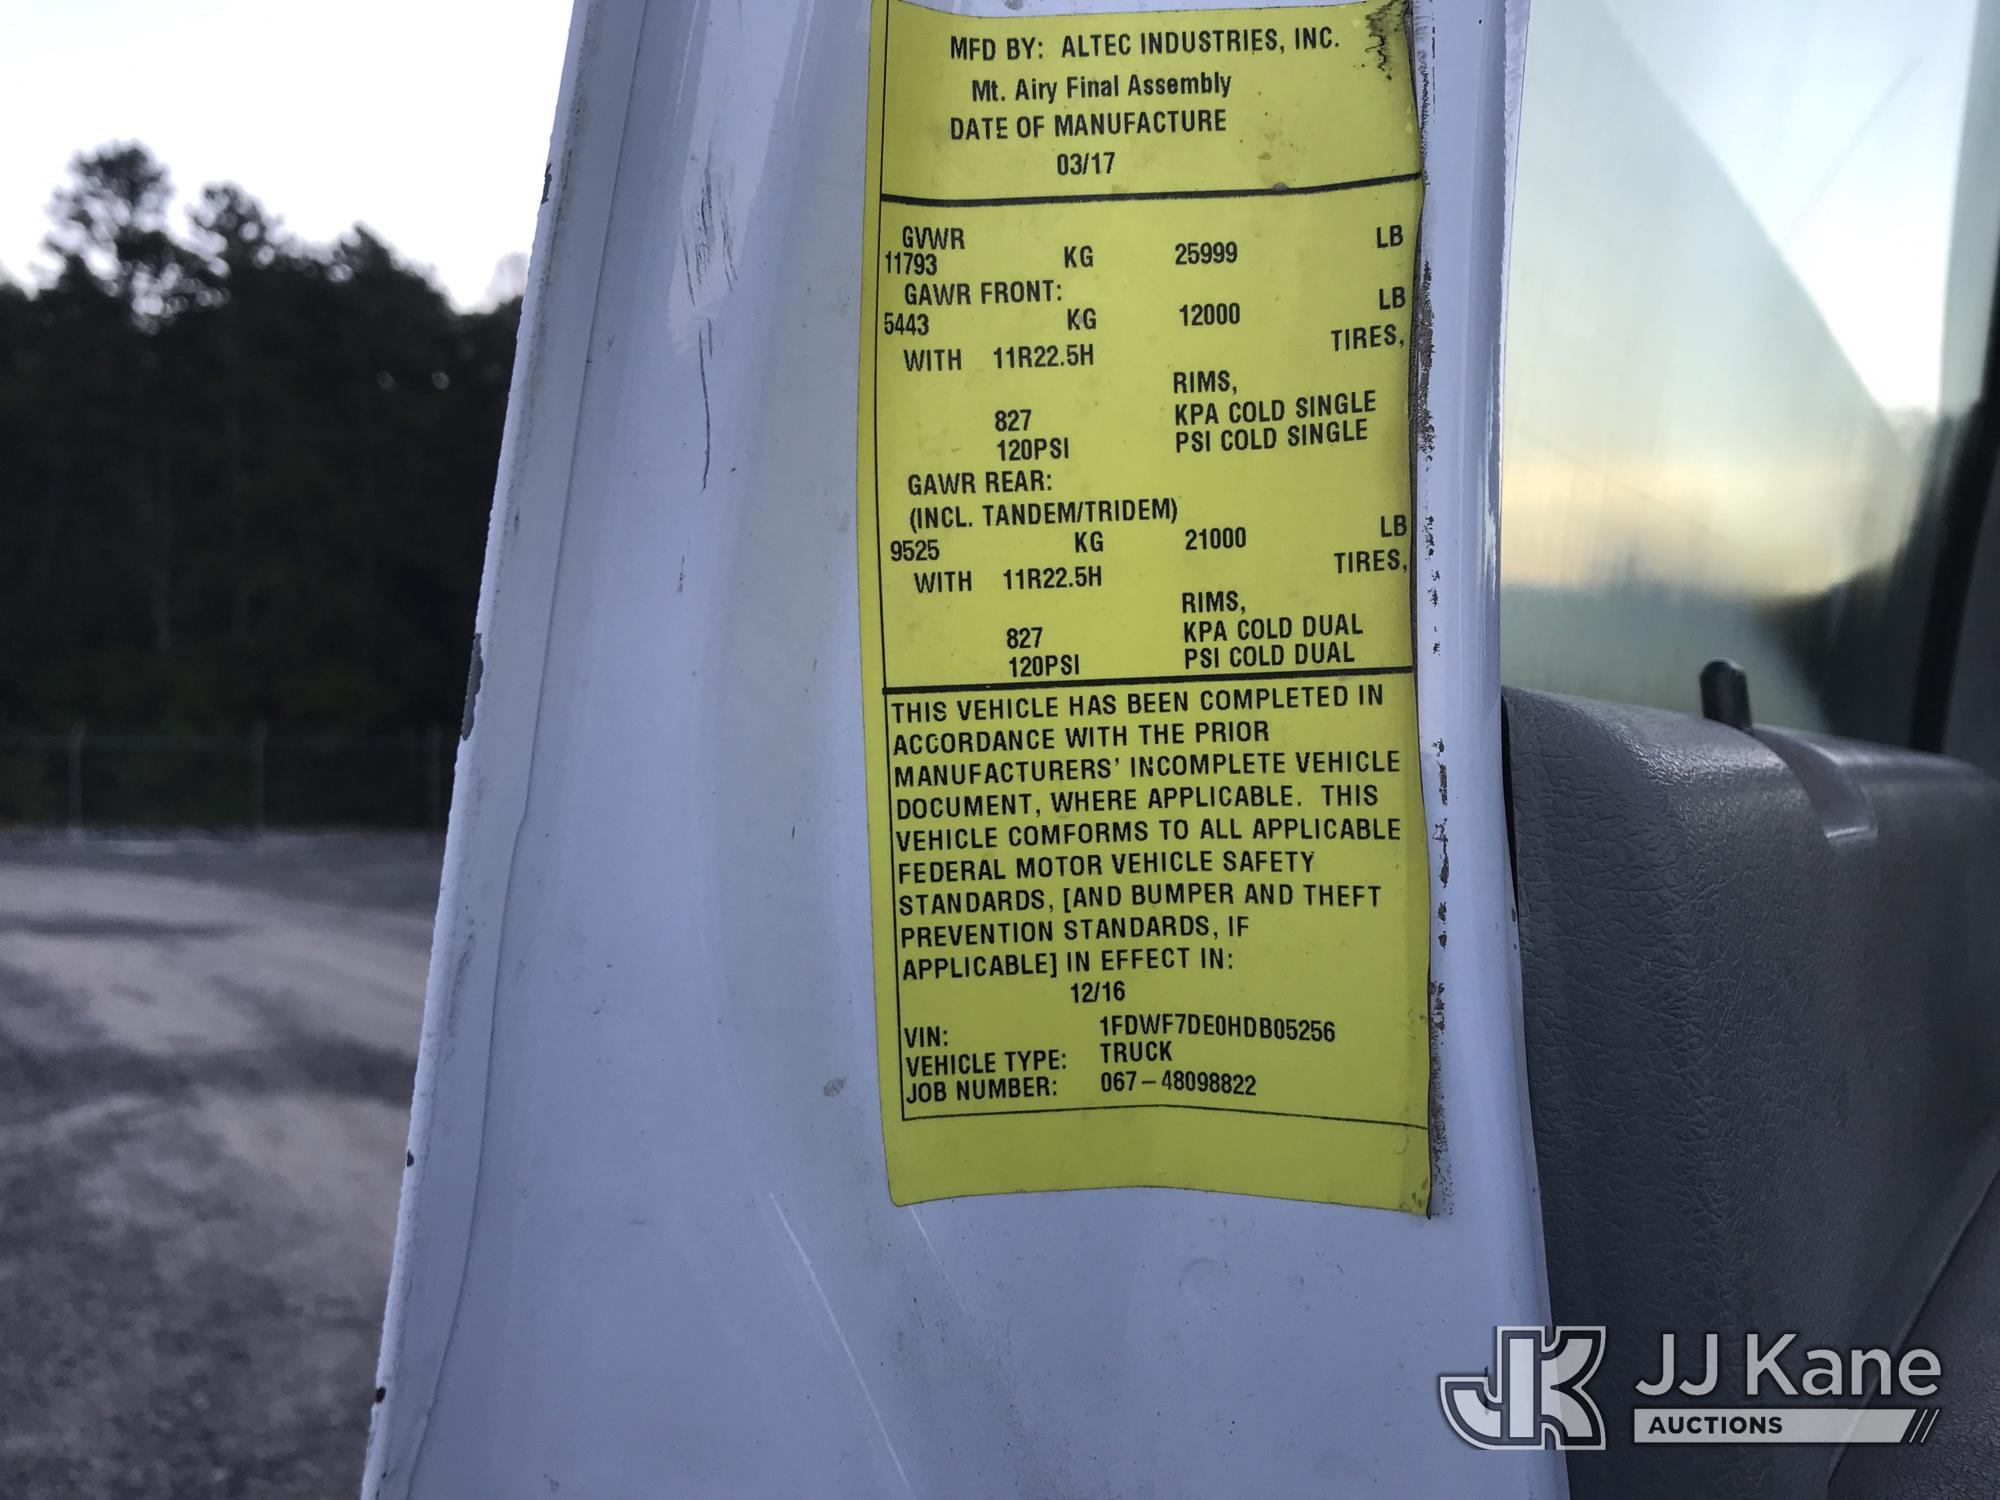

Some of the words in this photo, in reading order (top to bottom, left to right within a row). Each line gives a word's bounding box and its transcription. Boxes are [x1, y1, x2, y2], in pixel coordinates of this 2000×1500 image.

[950, 35, 996, 61] MFD
[1006, 36, 1043, 61] BY:
[1061, 33, 1131, 58] ALTEC
[1140, 28, 1285, 55] INDUSTRIES,
[1294, 26, 1339, 50] INC.
[971, 79, 1006, 102] Mt.
[1015, 77, 1058, 105] Airy
[1066, 74, 1119, 99] Final
[1127, 71, 1232, 98] Assembly
[950, 116, 1008, 141] DATE
[1016, 115, 1045, 139] OF
[1054, 108, 1227, 137] MANUFACTURE
[1056, 151, 1116, 176] 03/17
[885, 250, 938, 276] 11793
[1063, 244, 1094, 269] KG
[1174, 241, 1238, 266] 25999
[1376, 224, 1404, 249] LB
[902, 225, 966, 250] GVWR
[904, 282, 972, 306] GAWR
[980, 279, 1062, 305] FRONT:
[884, 311, 930, 336] 5443
[1067, 307, 1097, 331] KG
[1179, 302, 1241, 327] 12000
[1378, 286, 1407, 311] LB
[903, 348, 962, 372] WITH
[993, 343, 1094, 369] 11R22.5H
[1330, 323, 1405, 352] TIRES,
[1173, 369, 1237, 395] RIMS,
[994, 408, 1032, 432] 827
[1175, 402, 1219, 426] KPA
[1228, 399, 1285, 424] COLD
[1295, 389, 1376, 419] SINGLE
[996, 437, 1069, 462] 120PSI
[1175, 430, 1211, 454] PSI
[1220, 427, 1277, 452] COLD
[1287, 418, 1368, 447] SINGLE
[907, 472, 977, 496] GAWR
[985, 469, 1052, 493] REAR:
[909, 505, 973, 534] (INCL.
[982, 497, 1178, 527] TANDEM/TRIDEM)
[890, 538, 940, 562] 9525
[1074, 530, 1104, 554] KG
[1185, 526, 1247, 551] 21000
[1380, 513, 1408, 538] LB
[913, 570, 972, 594] WITH
[1002, 565, 1102, 591] 11R22.5H
[1333, 548, 1408, 574] TIRES,
[1181, 590, 1246, 615] RIMS,
[1006, 626, 1043, 650] 827
[1183, 620, 1228, 643] KPA
[1237, 616, 1293, 641] COLD
[1302, 612, 1364, 638] DUAL
[1008, 653, 1080, 678] 120PSI
[1184, 647, 1219, 670] PSI
[1229, 644, 1285, 668] COLD
[1294, 641, 1355, 665] DUAL
[890, 701, 947, 724] THIS
[956, 696, 1058, 721] VEHICLE
[1069, 694, 1117, 716] HAS
[1127, 691, 1188, 714] BEEN
[1200, 685, 1348, 711] COMPLETED
[1358, 683, 1383, 706] IN
[893, 728, 1055, 756] ACCORDANCE
[1064, 725, 1127, 749] WITH
[1138, 723, 1185, 745] THE
[1195, 720, 1270, 743] PRIOR
[1130, 752, 1286, 778] INCOMPLETE
[1295, 750, 1400, 774] VEHICLE
[896, 793, 1041, 820] DOCUMENT,
[1050, 788, 1137, 813] WHERE
[1147, 784, 1302, 809] APPLICABLE.
[1320, 784, 1378, 807] THIS
[895, 827, 998, 853] VEHICLE
[1008, 820, 1149, 847] COMFORMS
[1158, 818, 1189, 841] TO
[1199, 818, 1243, 840] ALL
[1252, 818, 1401, 841] APPLICABLE
[898, 858, 1006, 885] FEDERAL
[1016, 854, 1103, 879] MOTOR
[1110, 850, 1213, 875] VEHICLE
[1223, 850, 1314, 873] SAFETY
[899, 888, 1054, 917] STANDARDS,
[1063, 885, 1122, 914] [AND
[1131, 882, 1234, 906] BUMPER
[1244, 883, 1294, 906] AND
[1302, 884, 1382, 908] THEFT
[901, 920, 1053, 949] PREVENTION
[1063, 915, 1218, 941] STANDARDS,
[1228, 915, 1249, 937] IF
[902, 952, 1058, 981] APPLICABLE]
[1066, 950, 1090, 973] IN
[1101, 947, 1190, 971] EFFECT
[1200, 947, 1233, 970] IN:
[1070, 980, 1126, 1004] 12/16
[903, 1025, 948, 1049] VIN:
[1099, 1013, 1336, 1043] 1FDWF7DE0HDB05256
[905, 1052, 996, 1078] VEHICLE
[1004, 1048, 1067, 1073] TYPE:
[1099, 1040, 1173, 1064] TRUCK
[905, 1081, 947, 1105] JOB
[956, 1075, 1057, 1101] NUMBER:
